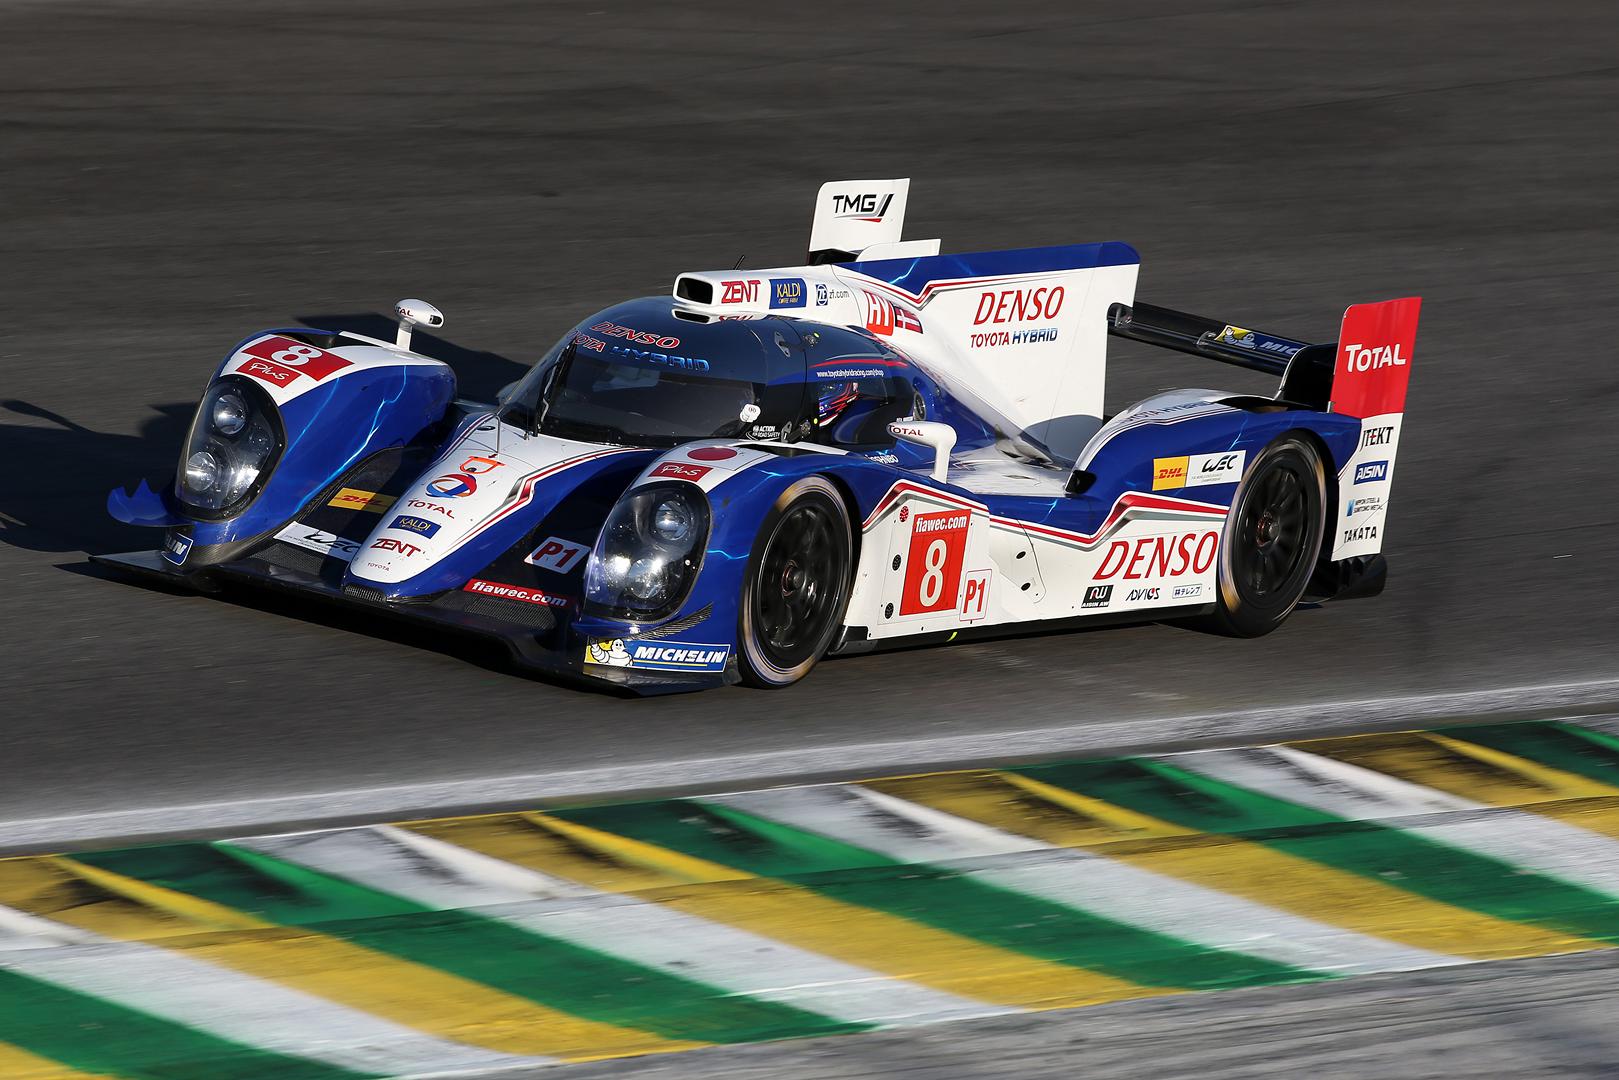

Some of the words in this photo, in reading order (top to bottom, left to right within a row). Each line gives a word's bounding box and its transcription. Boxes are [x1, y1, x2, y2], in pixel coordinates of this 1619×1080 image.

[833, 194, 877, 213] TMG
[721, 280, 761, 304] ZENT
[776, 282, 801, 298] KALDI
[973, 286, 1065, 326] DENSO
[590, 321, 681, 349] DENSO
[970, 331, 1010, 348] TOYOTA
[1012, 327, 1058, 345] HYBRID
[271, 345, 323, 366] 8
[1260, 341, 1301, 355] MIC
[609, 346, 710, 373] HYBRID
[1345, 343, 1407, 373] TOTAL
[888, 424, 925, 437] TOTAL
[1361, 426, 1394, 451] JTEKT
[1201, 454, 1239, 473] WEC
[1355, 464, 1386, 481] AISIN
[1158, 467, 1183, 480] DHL
[407, 499, 455, 519] TOTAL
[399, 516, 432, 531] KALDI
[915, 515, 968, 533] fiawec.com
[1344, 526, 1377, 544] TAKATA
[370, 538, 422, 557] ZENT
[532, 541, 580, 569] P1
[1092, 531, 1219, 580] DENSO
[367, 562, 390, 572] TOYOTA
[919, 539, 947, 607] 8
[472, 581, 568, 607] fiawec.com
[963, 578, 986, 614] P1
[1125, 587, 1161, 602] ADVICS
[634, 646, 727, 663] MICHELIN
